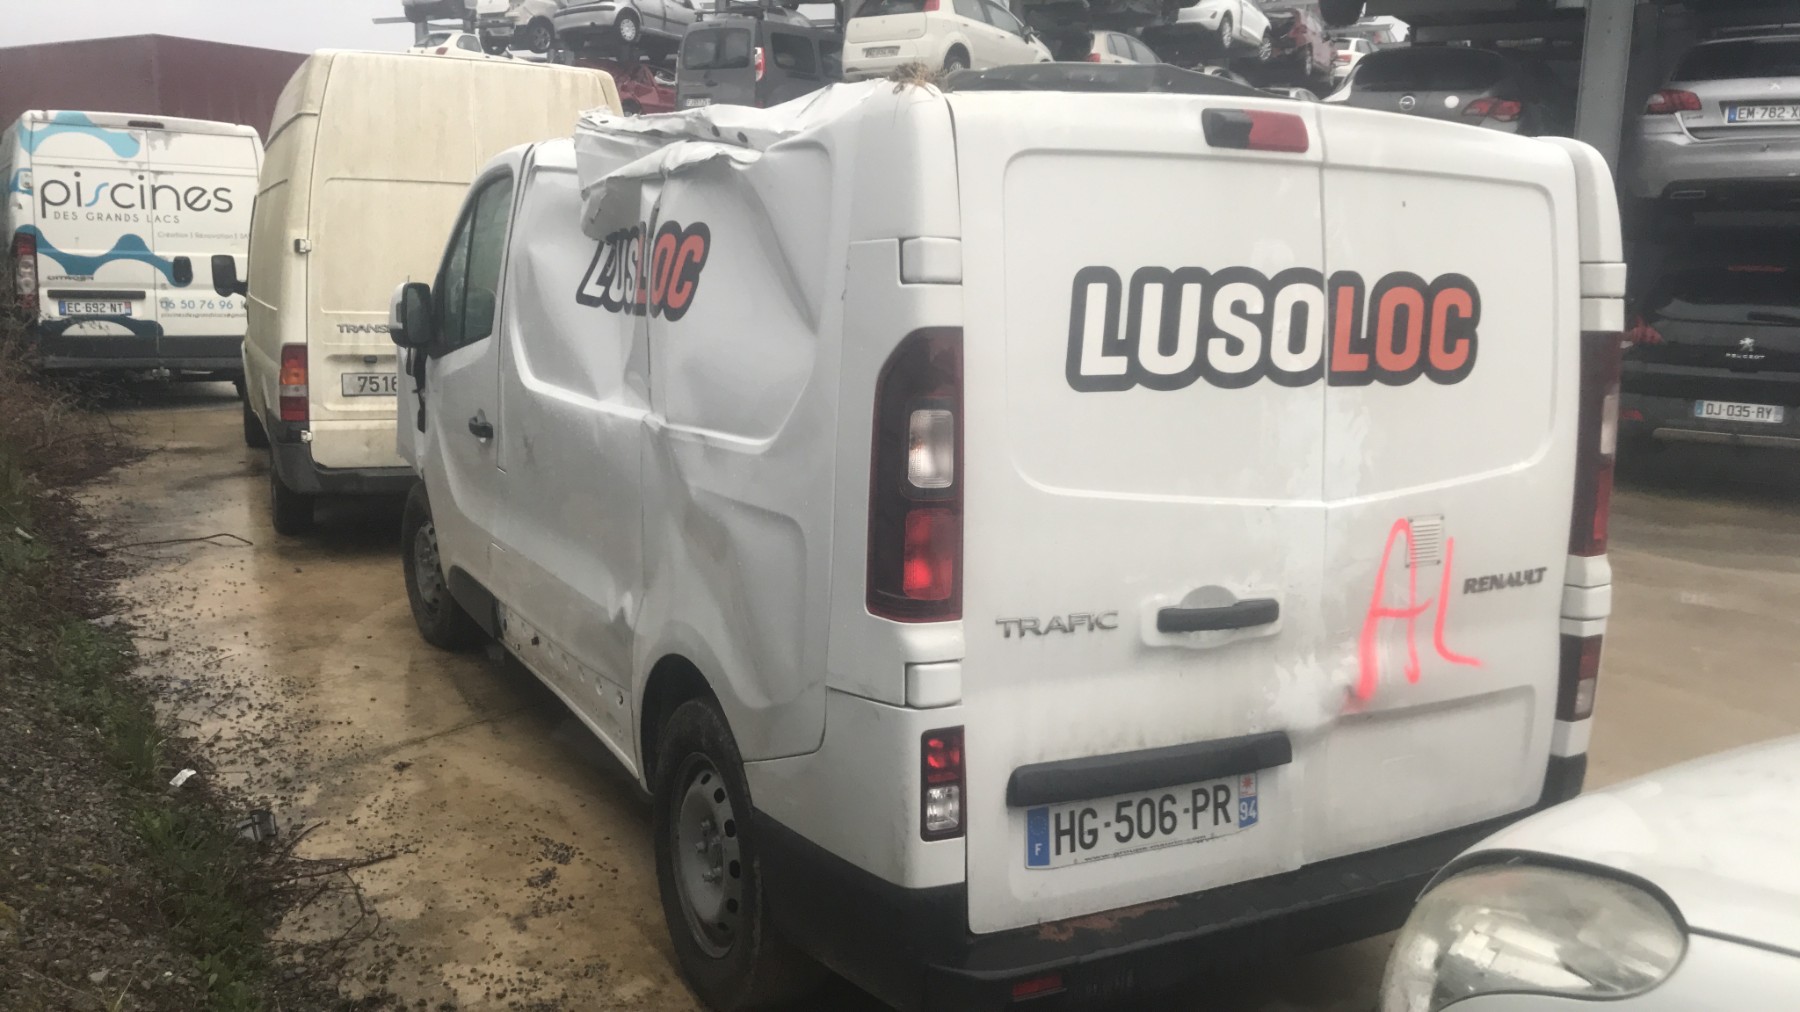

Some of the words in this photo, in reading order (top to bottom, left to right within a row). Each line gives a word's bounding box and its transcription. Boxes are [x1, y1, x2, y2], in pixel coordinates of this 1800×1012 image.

[40, 171, 233, 218] piscines
[53, 211, 78, 221] DES
[86, 212, 139, 223] GRANDS
[146, 214, 180, 224] LACS
[180, 300, 196, 310] 50
[200, 300, 215, 310] 76
[219, 300, 233, 310] 96
[1065, 266, 1481, 392] LUSOLOC
[1463, 566, 1548, 595] RENAULT
[995, 609, 1119, 639] TRAFIC
[1054, 784, 1232, 856] HG-506-PR
[1240, 799, 1257, 820] 94
